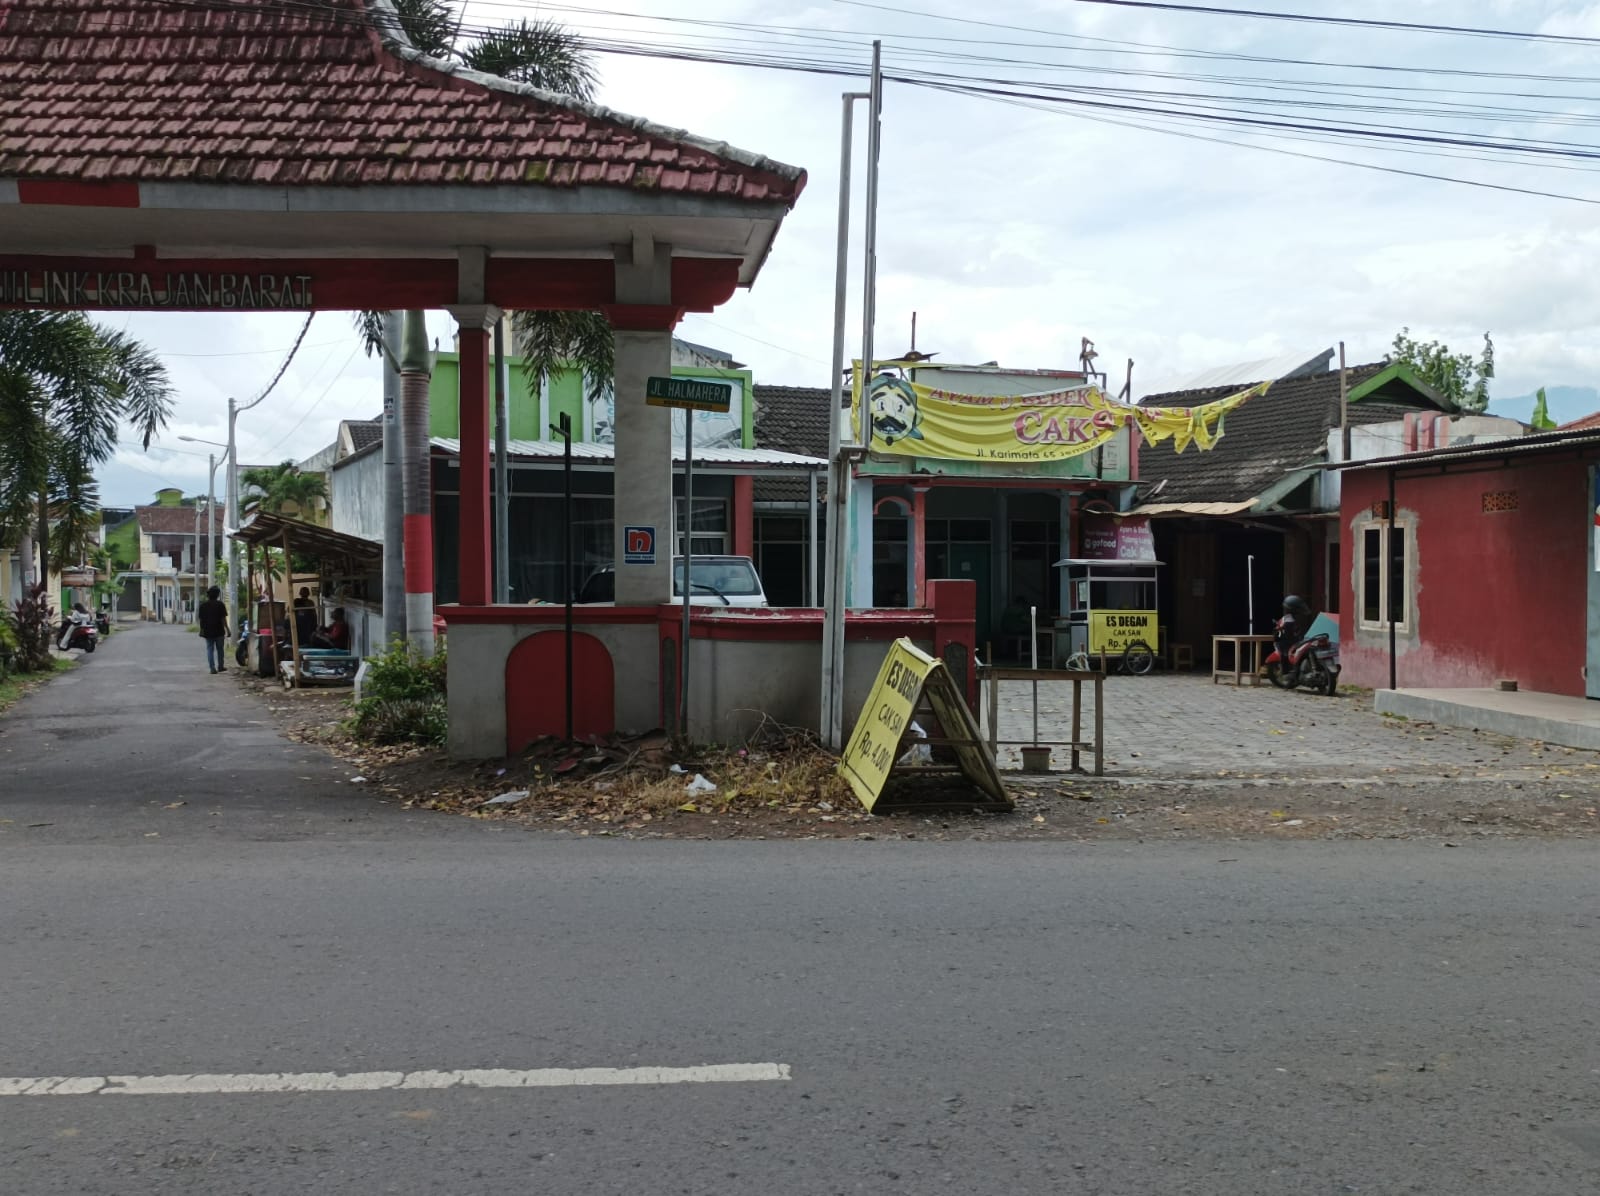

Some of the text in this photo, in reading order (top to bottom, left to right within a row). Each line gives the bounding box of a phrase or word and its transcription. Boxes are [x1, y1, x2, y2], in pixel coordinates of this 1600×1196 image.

[24, 271, 88, 305] LINK
[97, 272, 212, 306] KRAJAN
[220, 273, 312, 308] BARAT
[667, 382, 727, 402] HALMAHERA
[990, 449, 1040, 459] Karimata
[1106, 616, 1148, 627] ES DEGAN
[886, 660, 904, 689] ES
[878, 703, 895, 727] CAK
[858, 731, 873, 759] Rp.
